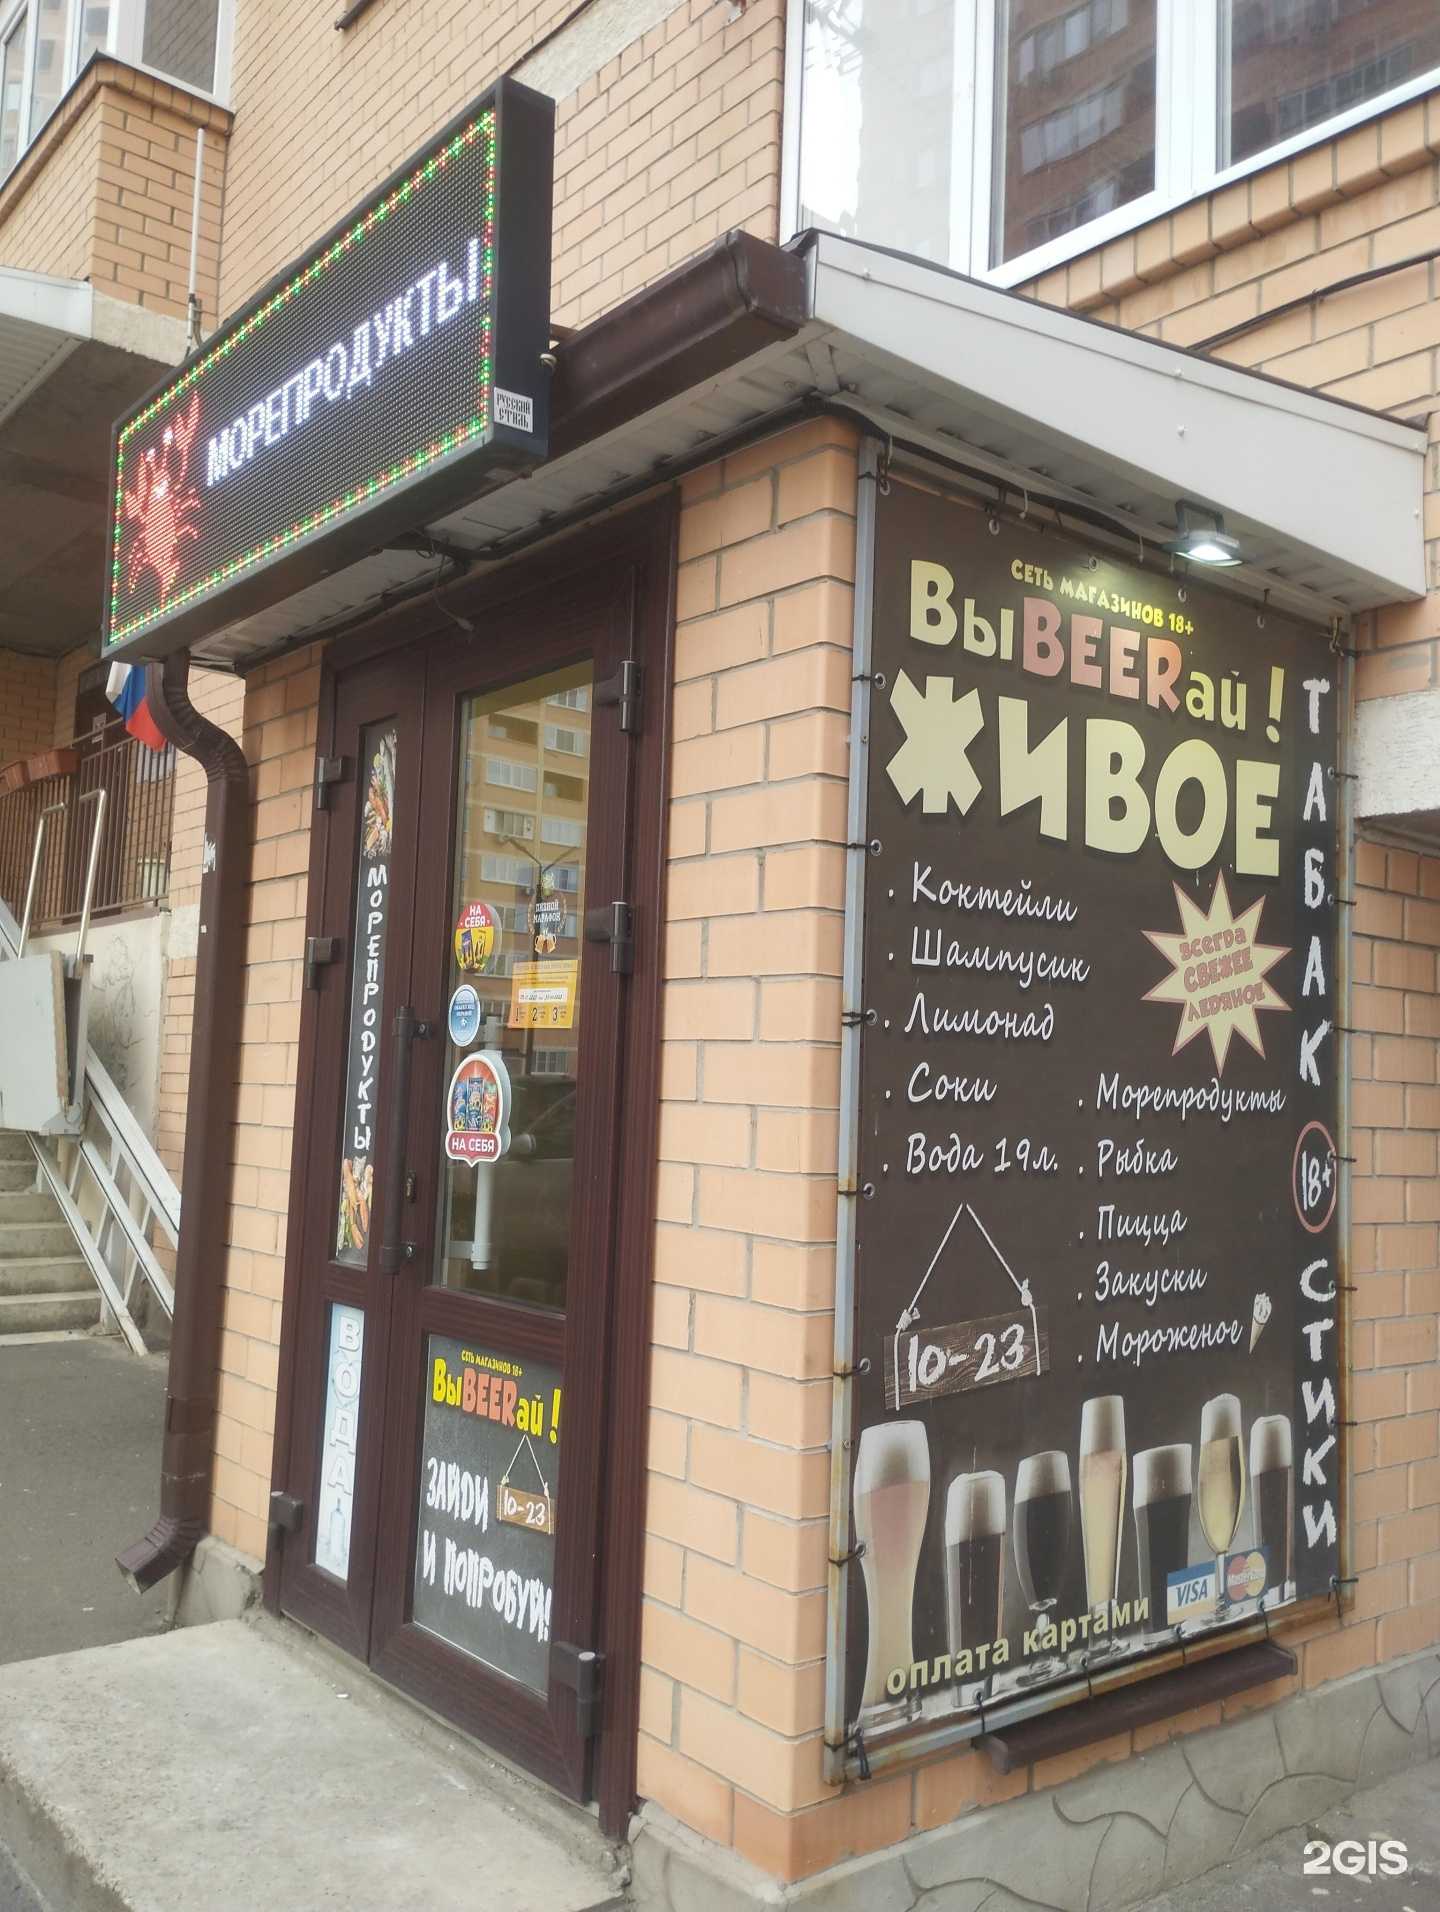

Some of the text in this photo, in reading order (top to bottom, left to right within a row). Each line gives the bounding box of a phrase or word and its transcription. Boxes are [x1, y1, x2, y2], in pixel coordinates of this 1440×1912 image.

[206, 238, 480, 487] МОРЕПРОДУКТЫ
[1010, 558, 1195, 637] СЕТЬ МАГАЗИНОВ 18+
[885, 667, 1281, 877] ЖИВОЕ
[912, 861, 1078, 923] Коктейли
[1299, 677, 1332, 1087] ТАБАК
[911, 926, 1091, 989] Шампусик
[1184, 946, 1254, 993] СВЕЖЕЕ
[354, 864, 388, 1151] МОРЕПРОДУКТЫ
[904, 992, 1056, 1041] Лимонад
[1188, 982, 1266, 1022] ЛЕДЯНОЕ
[907, 1062, 998, 1103] Соки
[1096, 1072, 1287, 1122] Морепродукты
[452, 1137, 495, 1153] НА СЕБЯ
[905, 1132, 984, 1174] Вода
[1097, 1139, 1178, 1179] Рыбка
[1302, 1150, 1332, 1212] 18+
[1097, 1205, 1188, 1246] Пицца
[1094, 1261, 1208, 1306] Закуски
[1096, 1316, 1244, 1366] Мороженое
[1300, 1258, 1336, 1549] СТИКИ
[423, 1529, 436, 1586] И
[1176, 1578, 1208, 1608] VISA
[886, 1597, 1150, 1695] оплата картами
